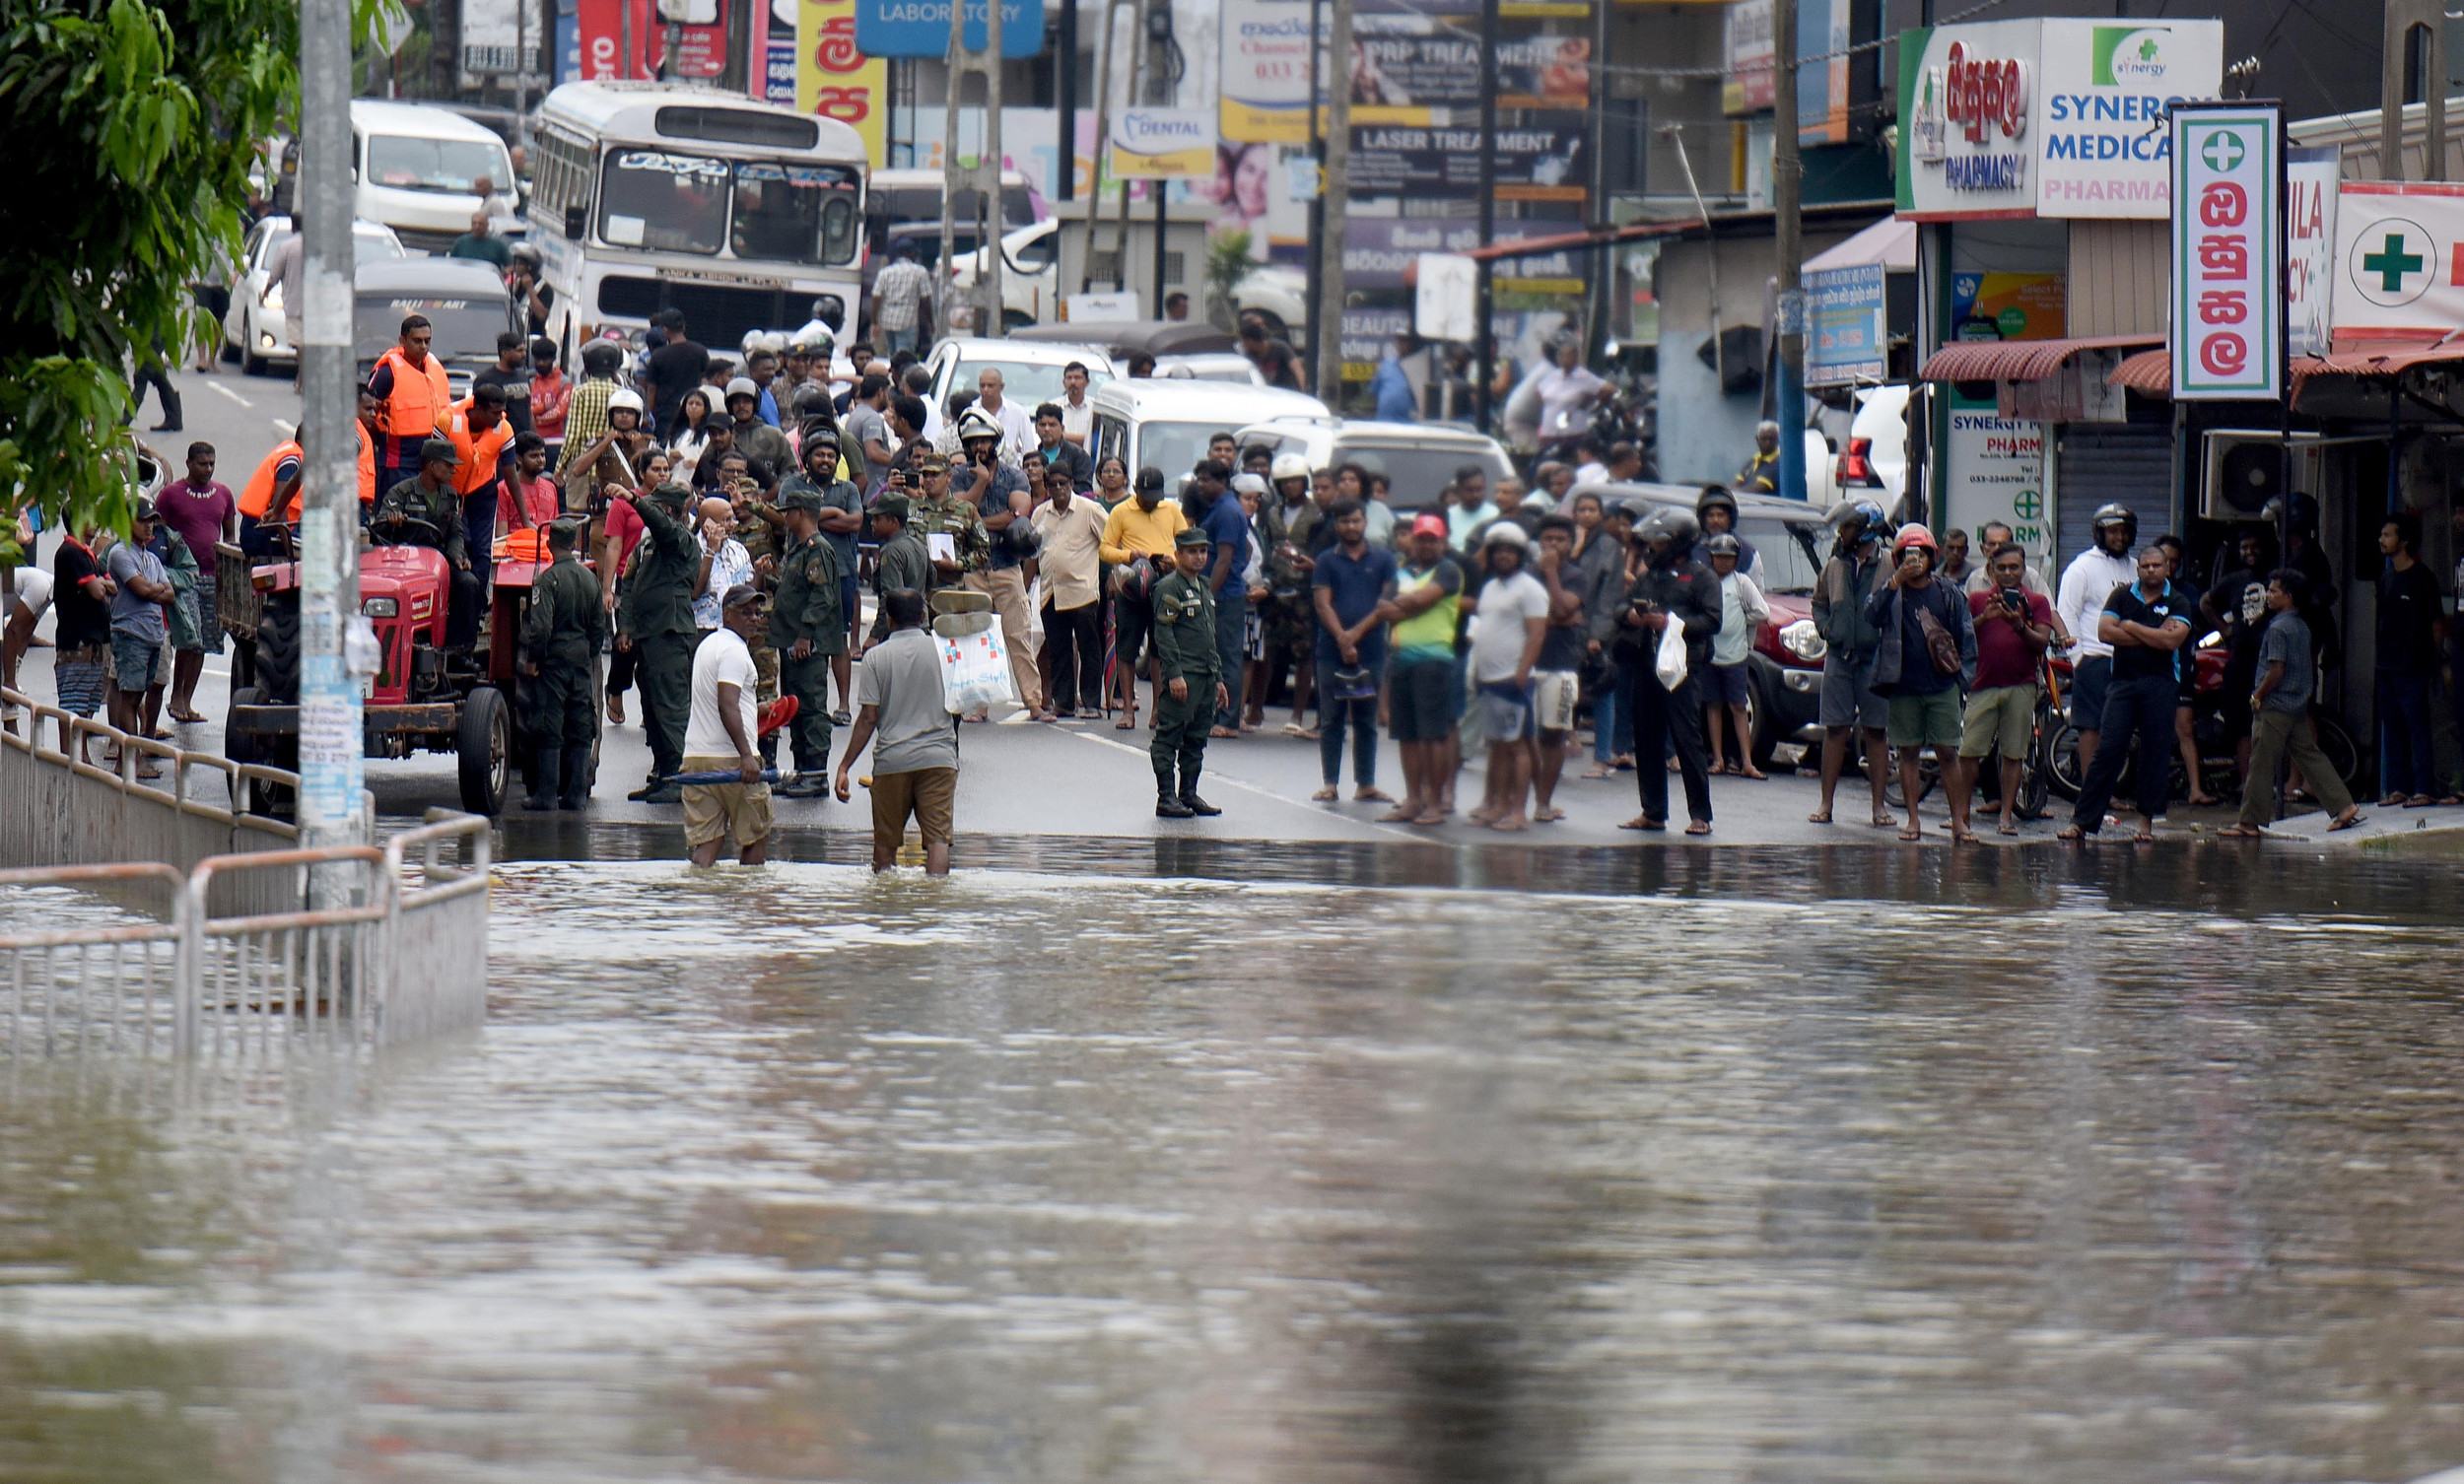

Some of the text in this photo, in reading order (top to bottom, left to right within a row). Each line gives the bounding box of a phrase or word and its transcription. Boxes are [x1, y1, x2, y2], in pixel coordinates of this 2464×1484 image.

[1362, 130, 1555, 152] LASER TREAMENT
[1946, 154, 2022, 188] PHARMACY
[390, 299, 468, 310] RALLI ART
